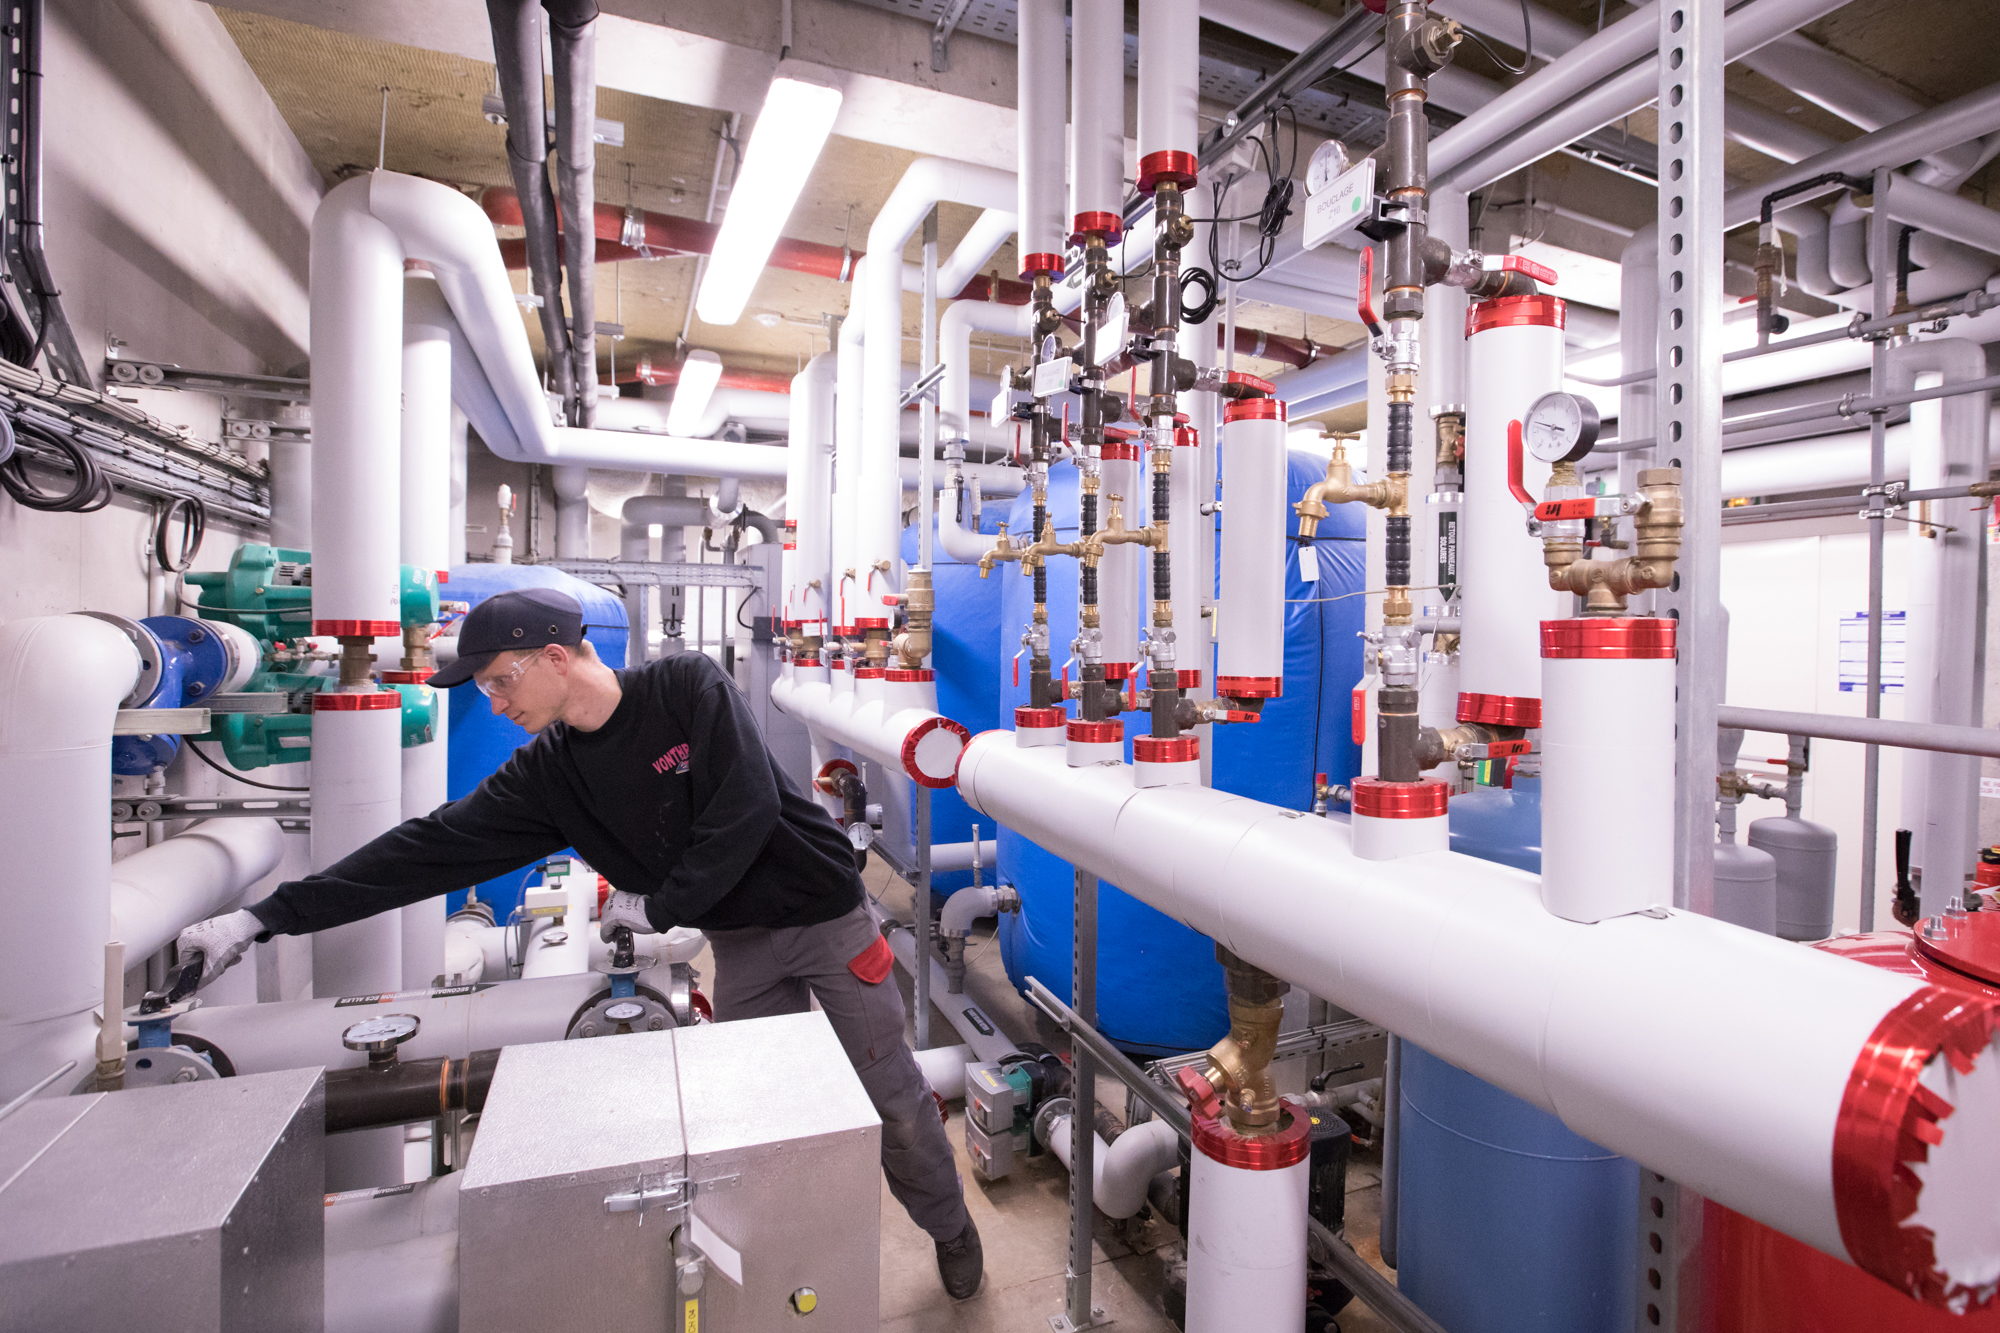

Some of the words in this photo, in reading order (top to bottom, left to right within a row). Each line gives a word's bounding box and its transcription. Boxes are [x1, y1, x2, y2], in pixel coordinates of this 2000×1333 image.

[1317, 183, 1354, 214] BOUCLAGE
[381, 990, 426, 1000] PRODUCTION
[427, 986, 469, 996] SECONDAIRE
[341, 996, 364, 1004] ALLER
[371, 1184, 412, 1196] SECONDAIRE
[325, 1191, 370, 1203] PRODUCTION
